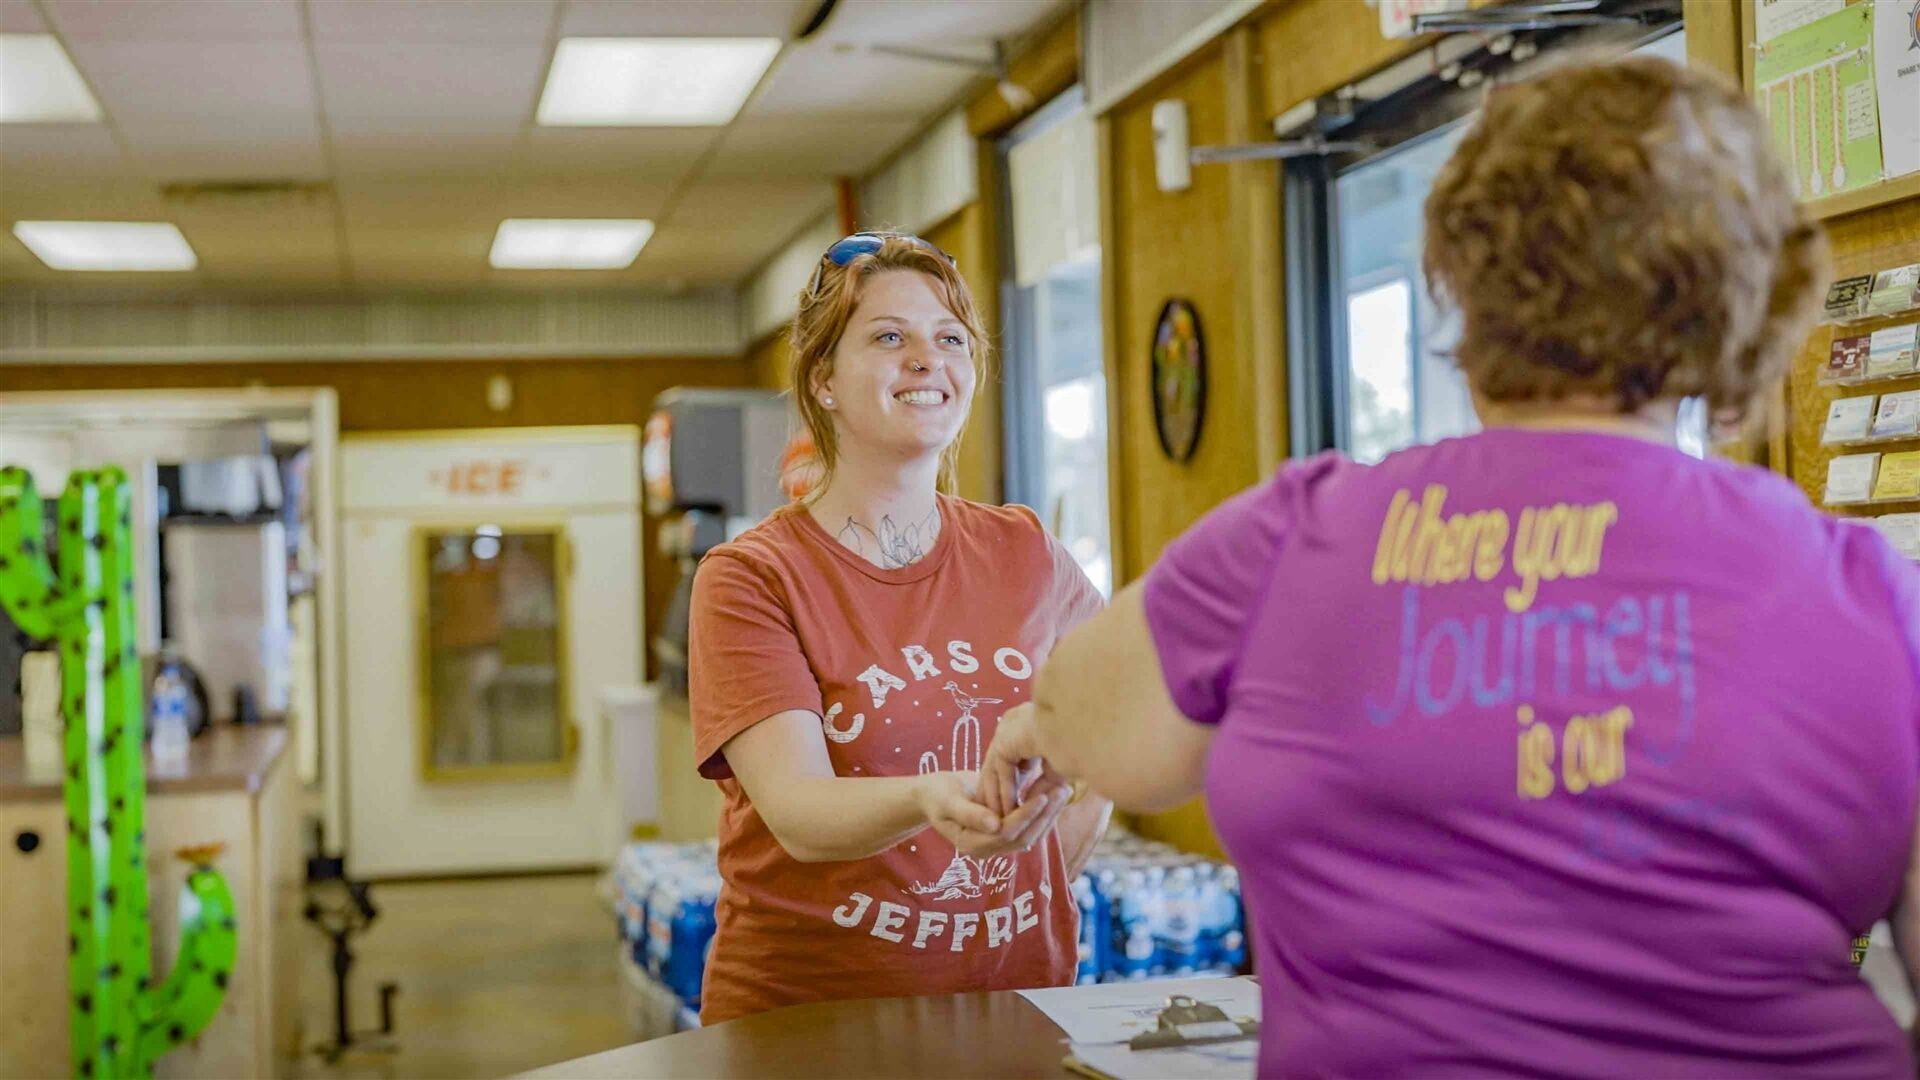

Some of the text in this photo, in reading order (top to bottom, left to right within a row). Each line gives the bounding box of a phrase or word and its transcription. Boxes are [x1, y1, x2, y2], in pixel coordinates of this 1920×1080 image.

[447, 458, 528, 495] ICE
[1372, 484, 1618, 613] Where your
[824, 640, 1033, 744] CARSO
[1362, 585, 1695, 766] Journey
[1517, 704, 1634, 799] is our
